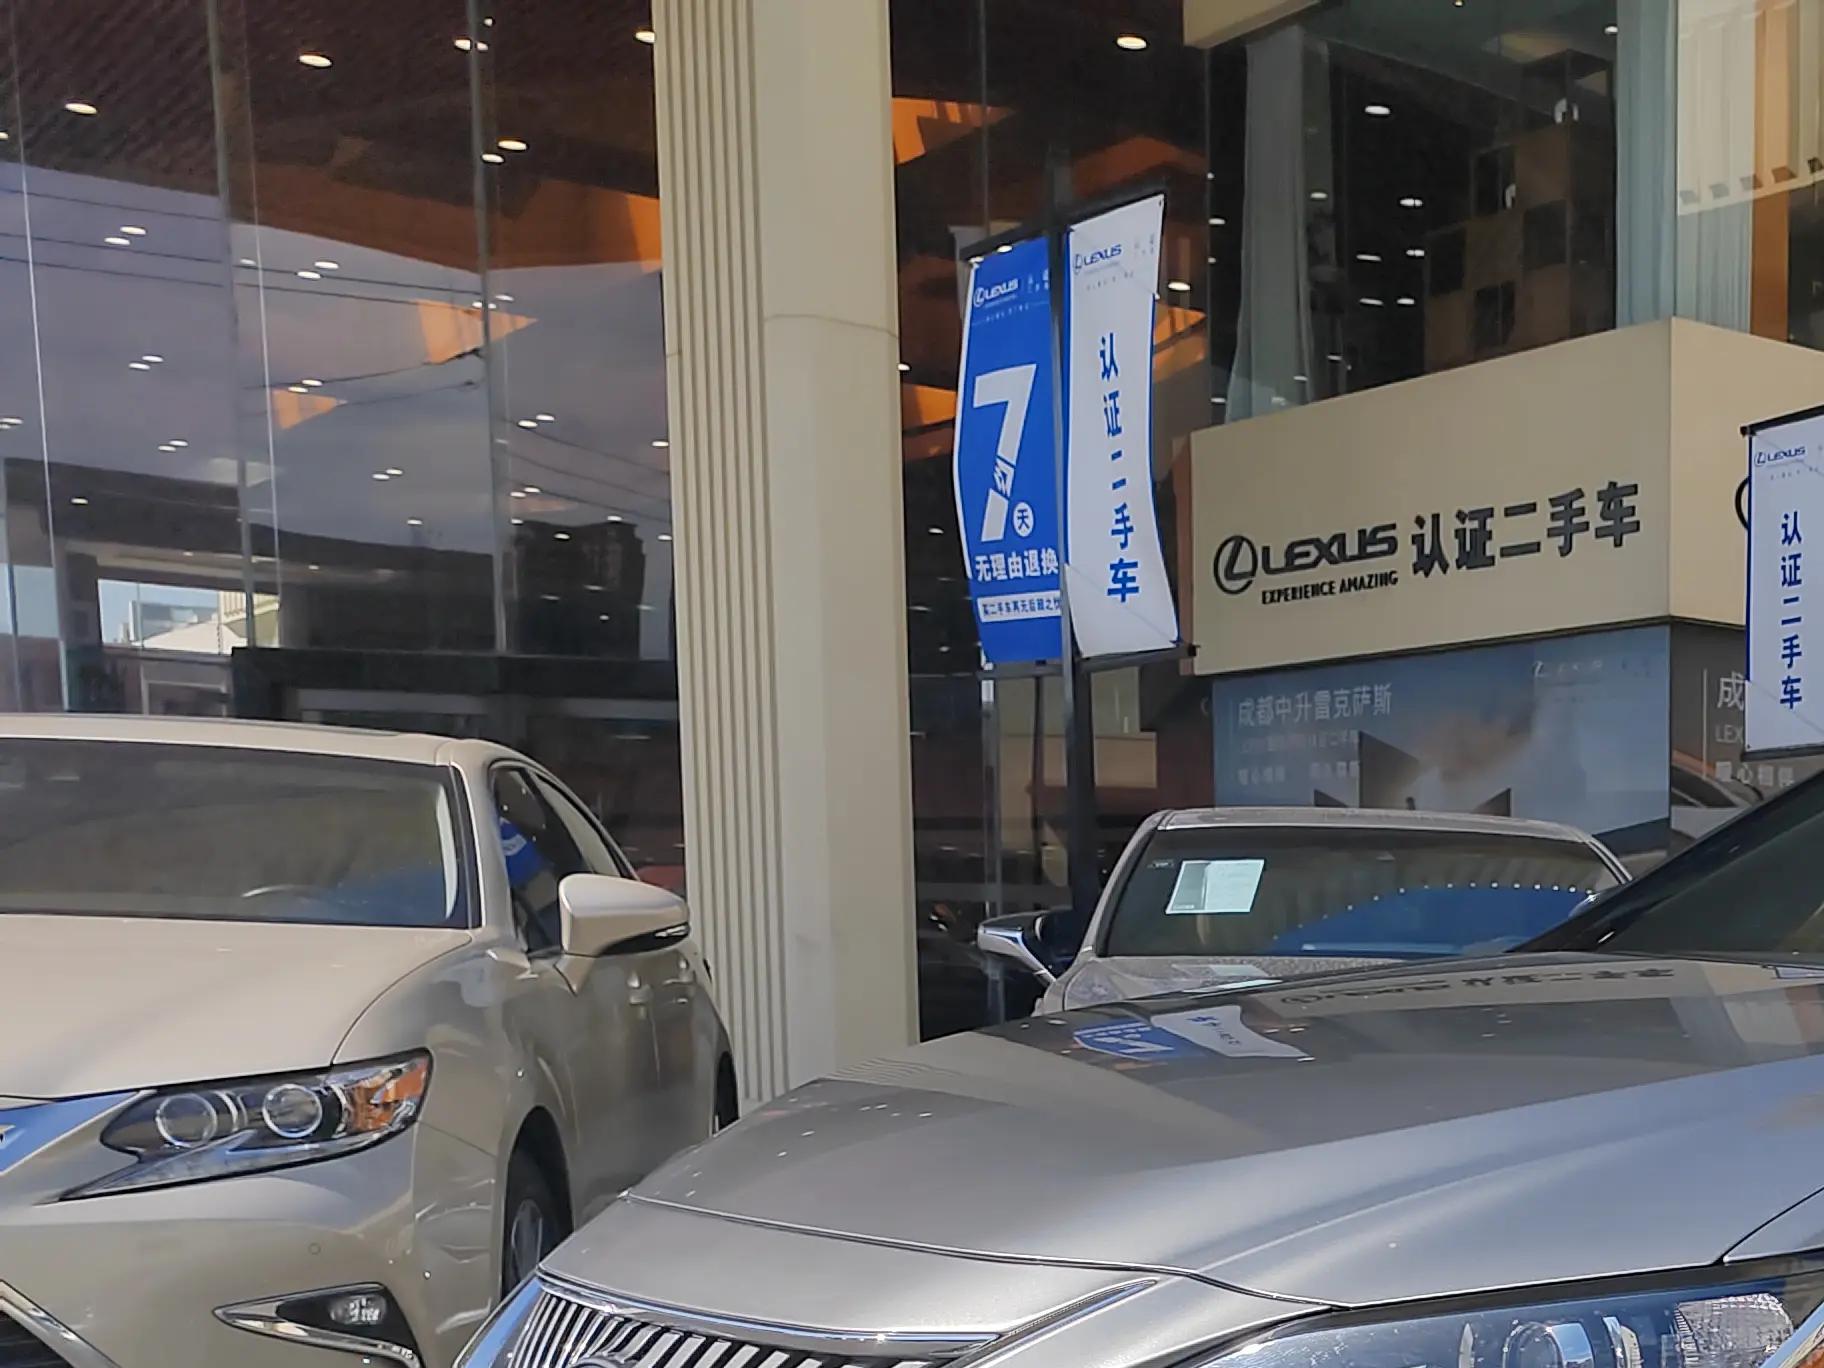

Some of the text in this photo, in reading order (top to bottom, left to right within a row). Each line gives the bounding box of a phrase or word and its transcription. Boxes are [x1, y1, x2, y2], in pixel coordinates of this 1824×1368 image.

[1084, 244, 1122, 266] LEXUS
[985, 278, 1019, 300] LEXUS
[973, 363, 1037, 542] 7
[1016, 508, 1031, 531] 天
[1099, 332, 1140, 603] 认证二手车
[1767, 446, 1806, 462] LEXUS
[1261, 523, 1398, 575] LEXUS
[1411, 480, 1641, 579] 认证二手车
[975, 547, 1059, 582] 无理由退换
[1261, 570, 1399, 605] EXPERIENCE AMAZING
[1779, 511, 1802, 710] 认证二手车
[1238, 683, 1393, 729] 成都中升雷克萨斯
